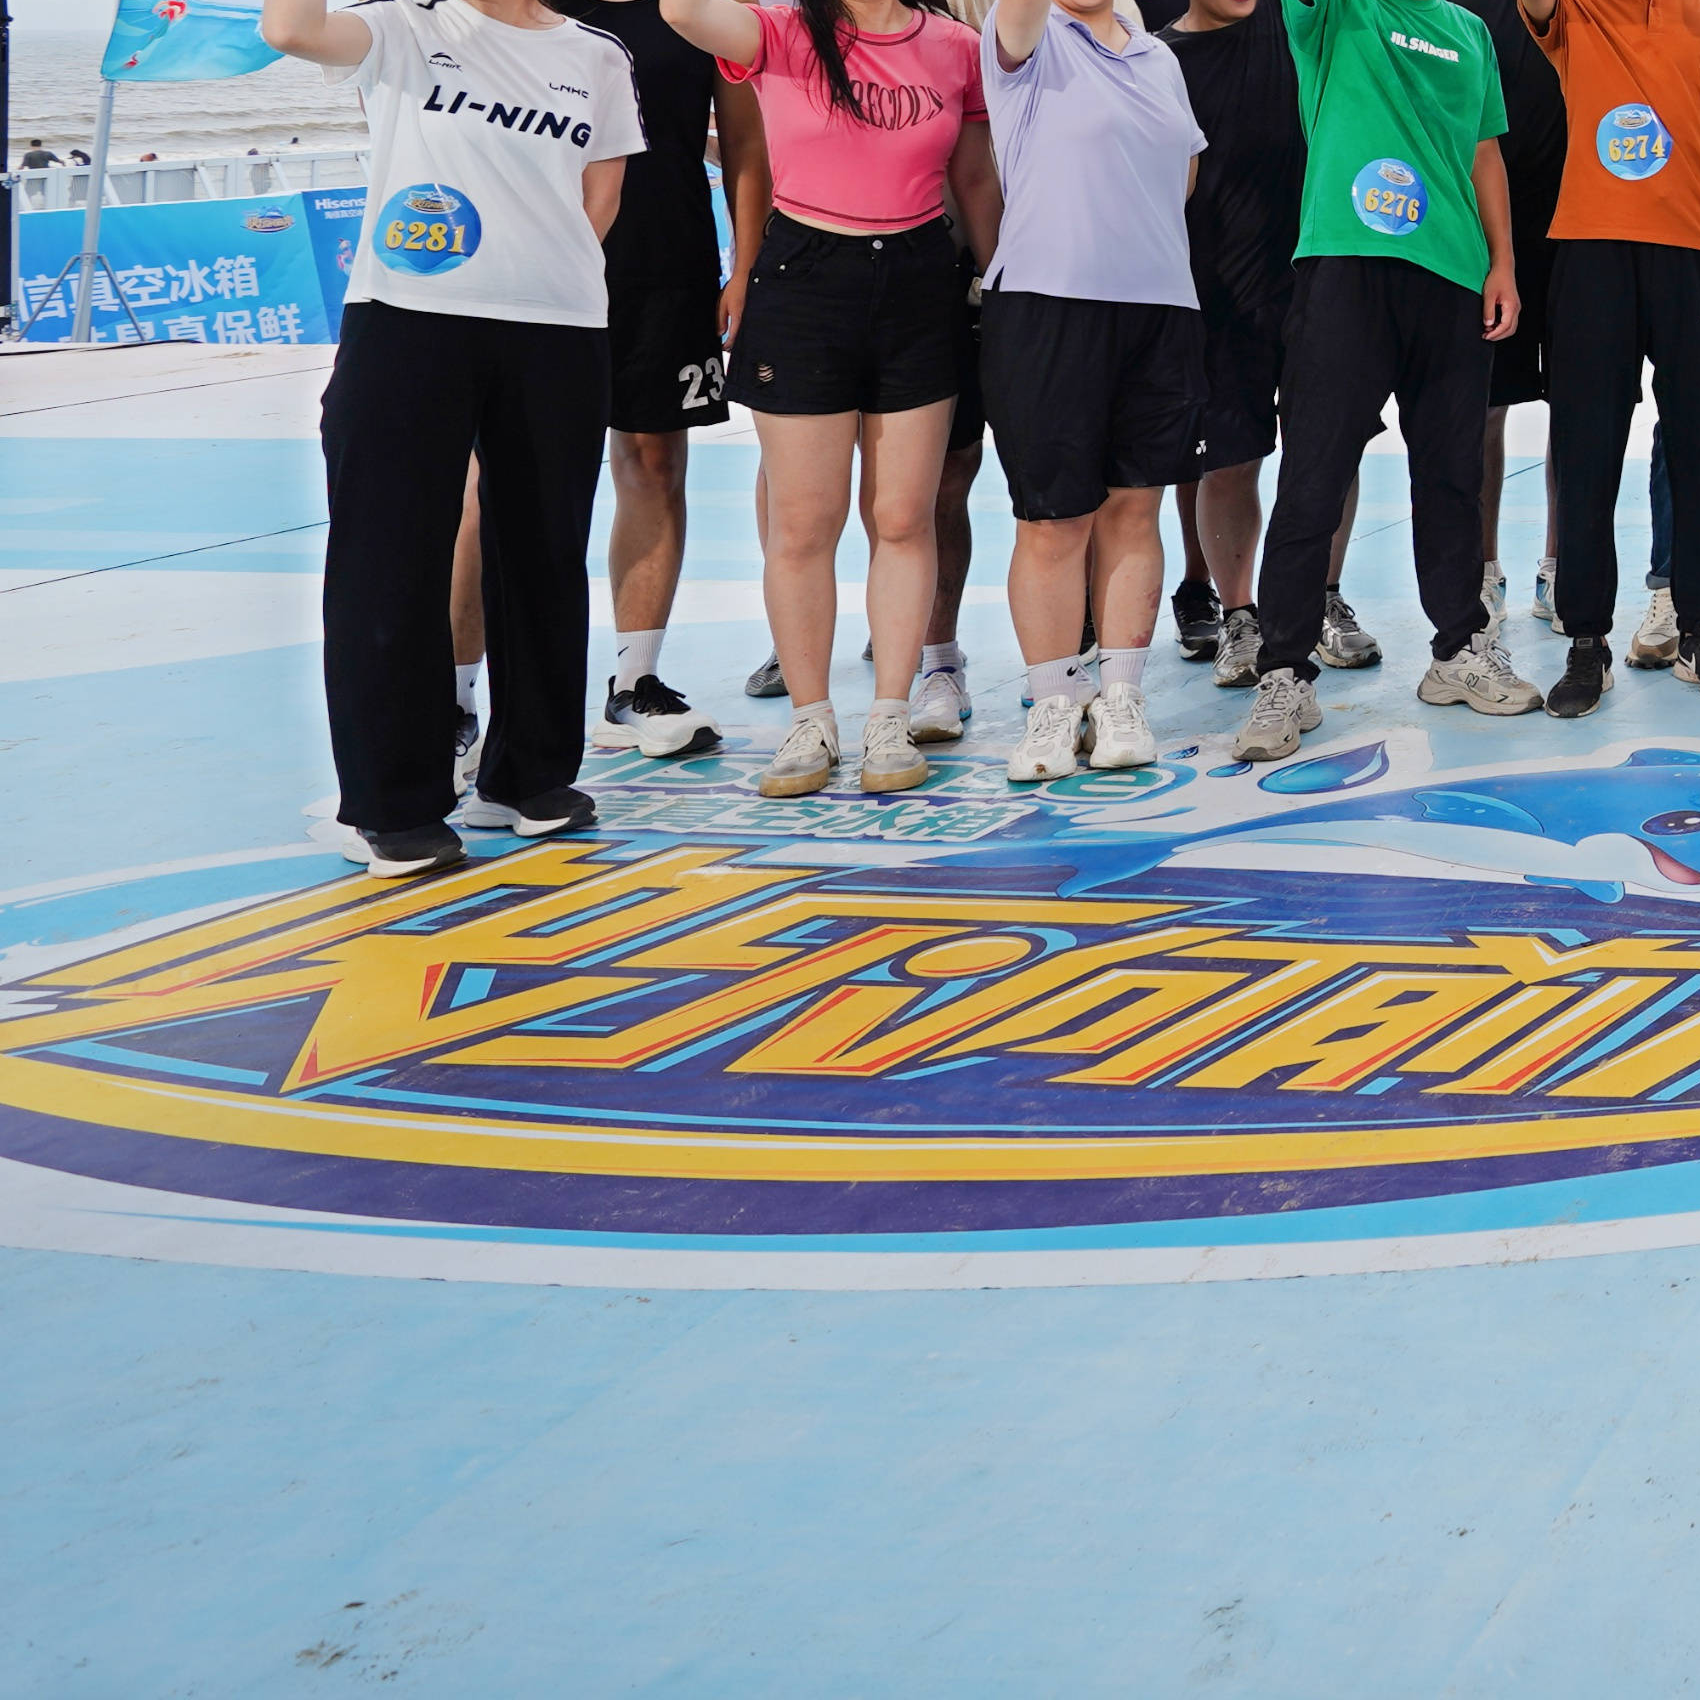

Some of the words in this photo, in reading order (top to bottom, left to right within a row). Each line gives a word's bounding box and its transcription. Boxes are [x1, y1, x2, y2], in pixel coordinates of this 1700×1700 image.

[423, 84, 592, 149] LI-NING
[833, 79, 944, 131] RECIOUS
[1608, 133, 1667, 163] 6274
[1364, 187, 1421, 222] 6276
[385, 221, 467, 254] 6281
[678, 356, 728, 410] 23
